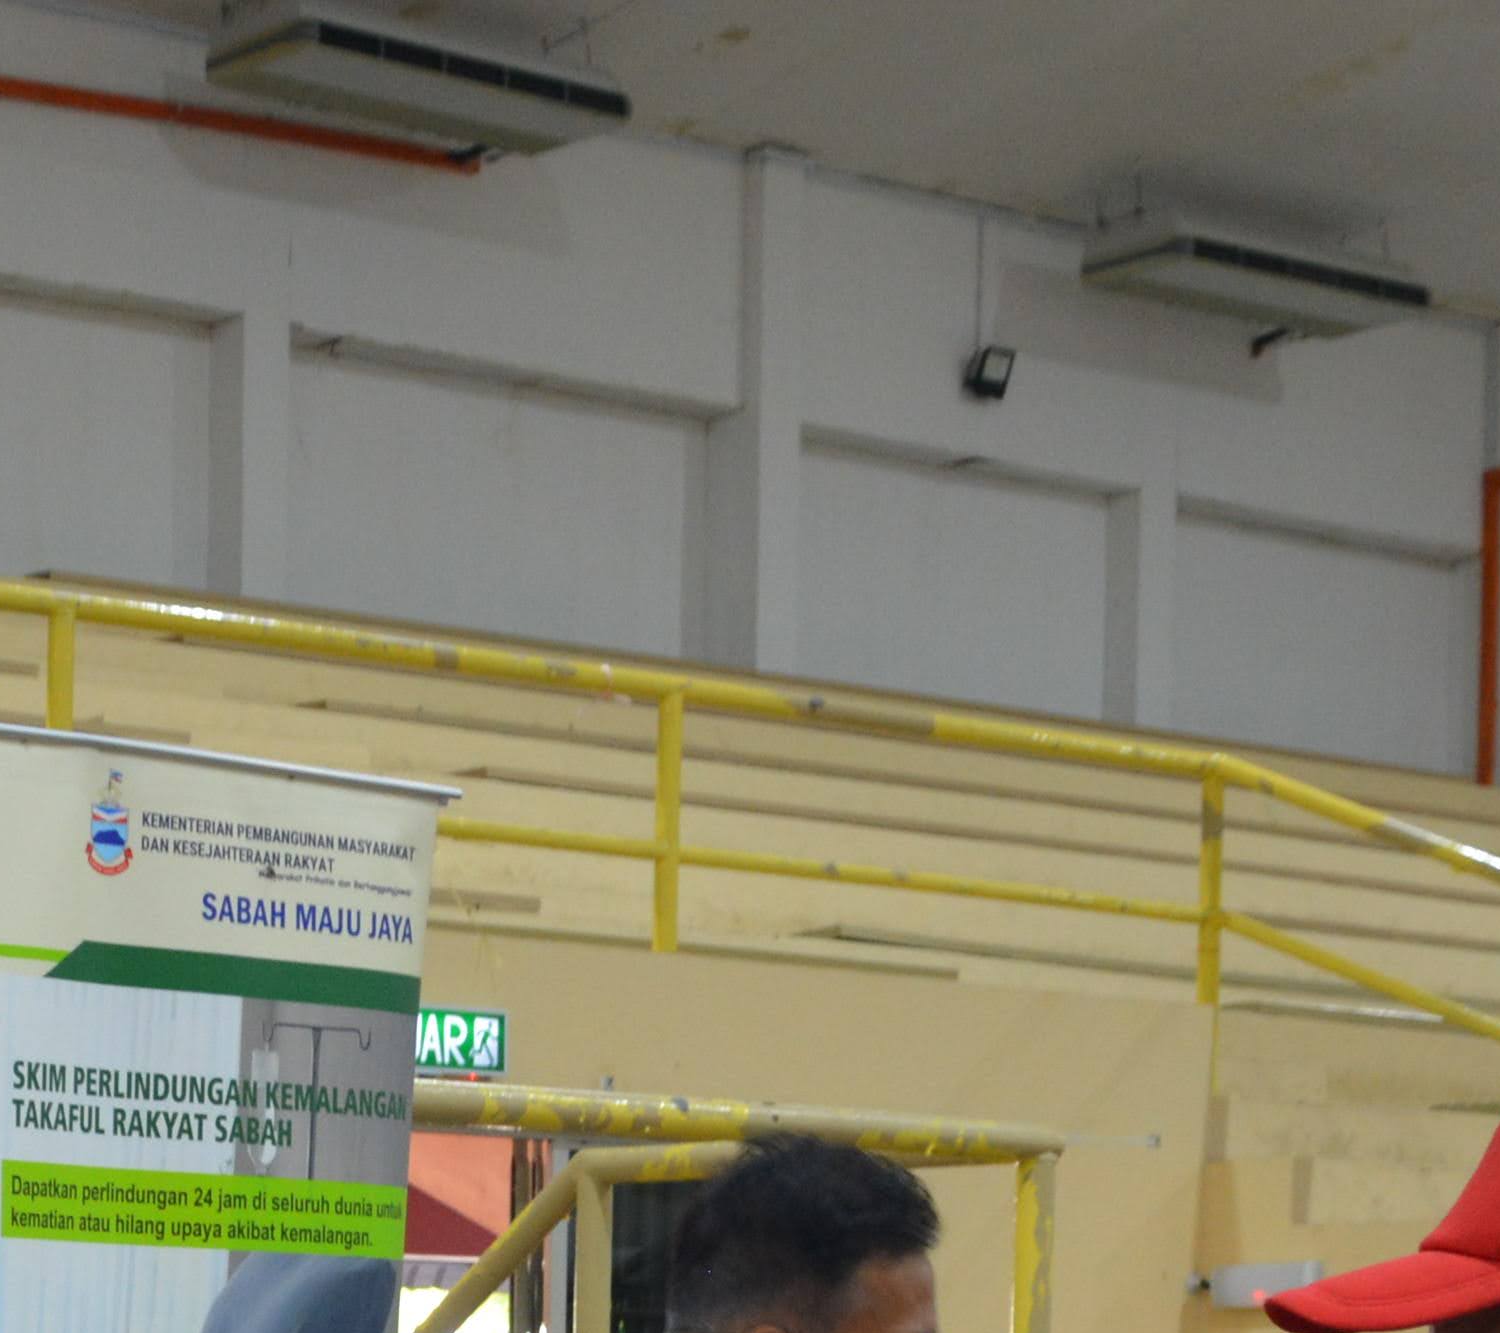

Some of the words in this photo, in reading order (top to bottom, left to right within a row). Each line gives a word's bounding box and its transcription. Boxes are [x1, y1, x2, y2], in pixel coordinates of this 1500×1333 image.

[141, 811, 234, 838] KEMENTERIAN
[237, 823, 334, 850] PEMBANGUNAN
[337, 836, 416, 862] MASYARAKAT
[141, 836, 169, 853] DAN
[173, 839, 281, 867] KESEJAHTERAAN
[284, 853, 336, 873] RAKYAT
[202, 892, 286, 929] SABAH
[295, 902, 362, 937] MAJU
[368, 910, 414, 945] JAYA
[12, 1060, 67, 1093] SKIM
[73, 1066, 258, 1107] PERLINDUNGAN
[265, 1080, 406, 1121] KEMALANGAN
[13, 1098, 105, 1135] TAKAFUL
[112, 1108, 207, 1142] RAKYAT
[214, 1114, 293, 1147] SABAH
[11, 1175, 78, 1201] Dapatkan
[81, 1182, 188, 1210] perlindungan
[194, 1187, 214, 1207] 24
[217, 1190, 248, 1213] jam
[252, 1190, 267, 1212] di
[271, 1191, 330, 1215] seluruh
[334, 1195, 373, 1218] dunia
[10, 1208, 75, 1231] kematian
[78, 1214, 110, 1233] atau
[115, 1213, 166, 1240] hilang
[171, 1220, 222, 1241] upaya
[227, 1217, 275, 1241] akibat
[280, 1221, 373, 1249] kemalangan.
